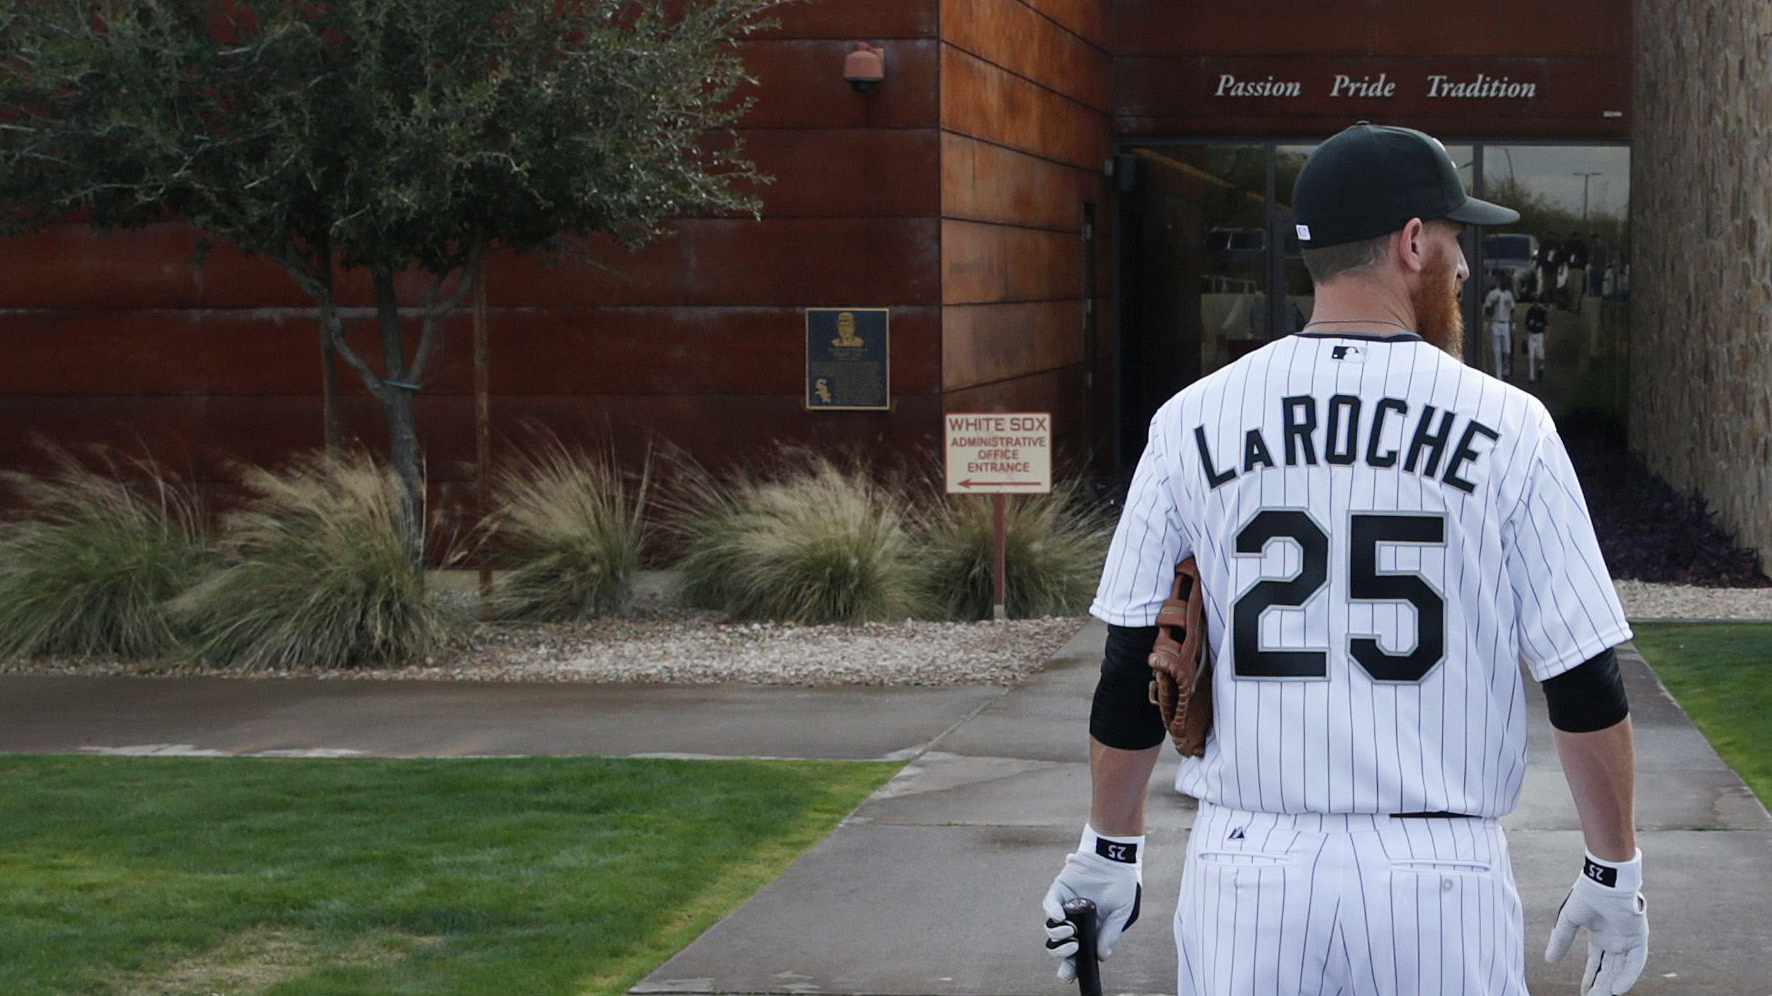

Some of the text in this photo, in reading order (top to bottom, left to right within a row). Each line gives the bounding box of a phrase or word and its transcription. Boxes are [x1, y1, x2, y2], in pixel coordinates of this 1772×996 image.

[1214, 73, 1537, 97] Passion Pride Tradition
[948, 417, 1047, 432] WHITE SOX
[951, 436, 1046, 448] ADMINISTRATIVE
[977, 448, 1020, 460] OFFICE
[967, 461, 1030, 473] ENTRANCE
[1229, 505, 1450, 685] 25
[1108, 844, 1126, 860] 25
[1589, 864, 1604, 881] 25
